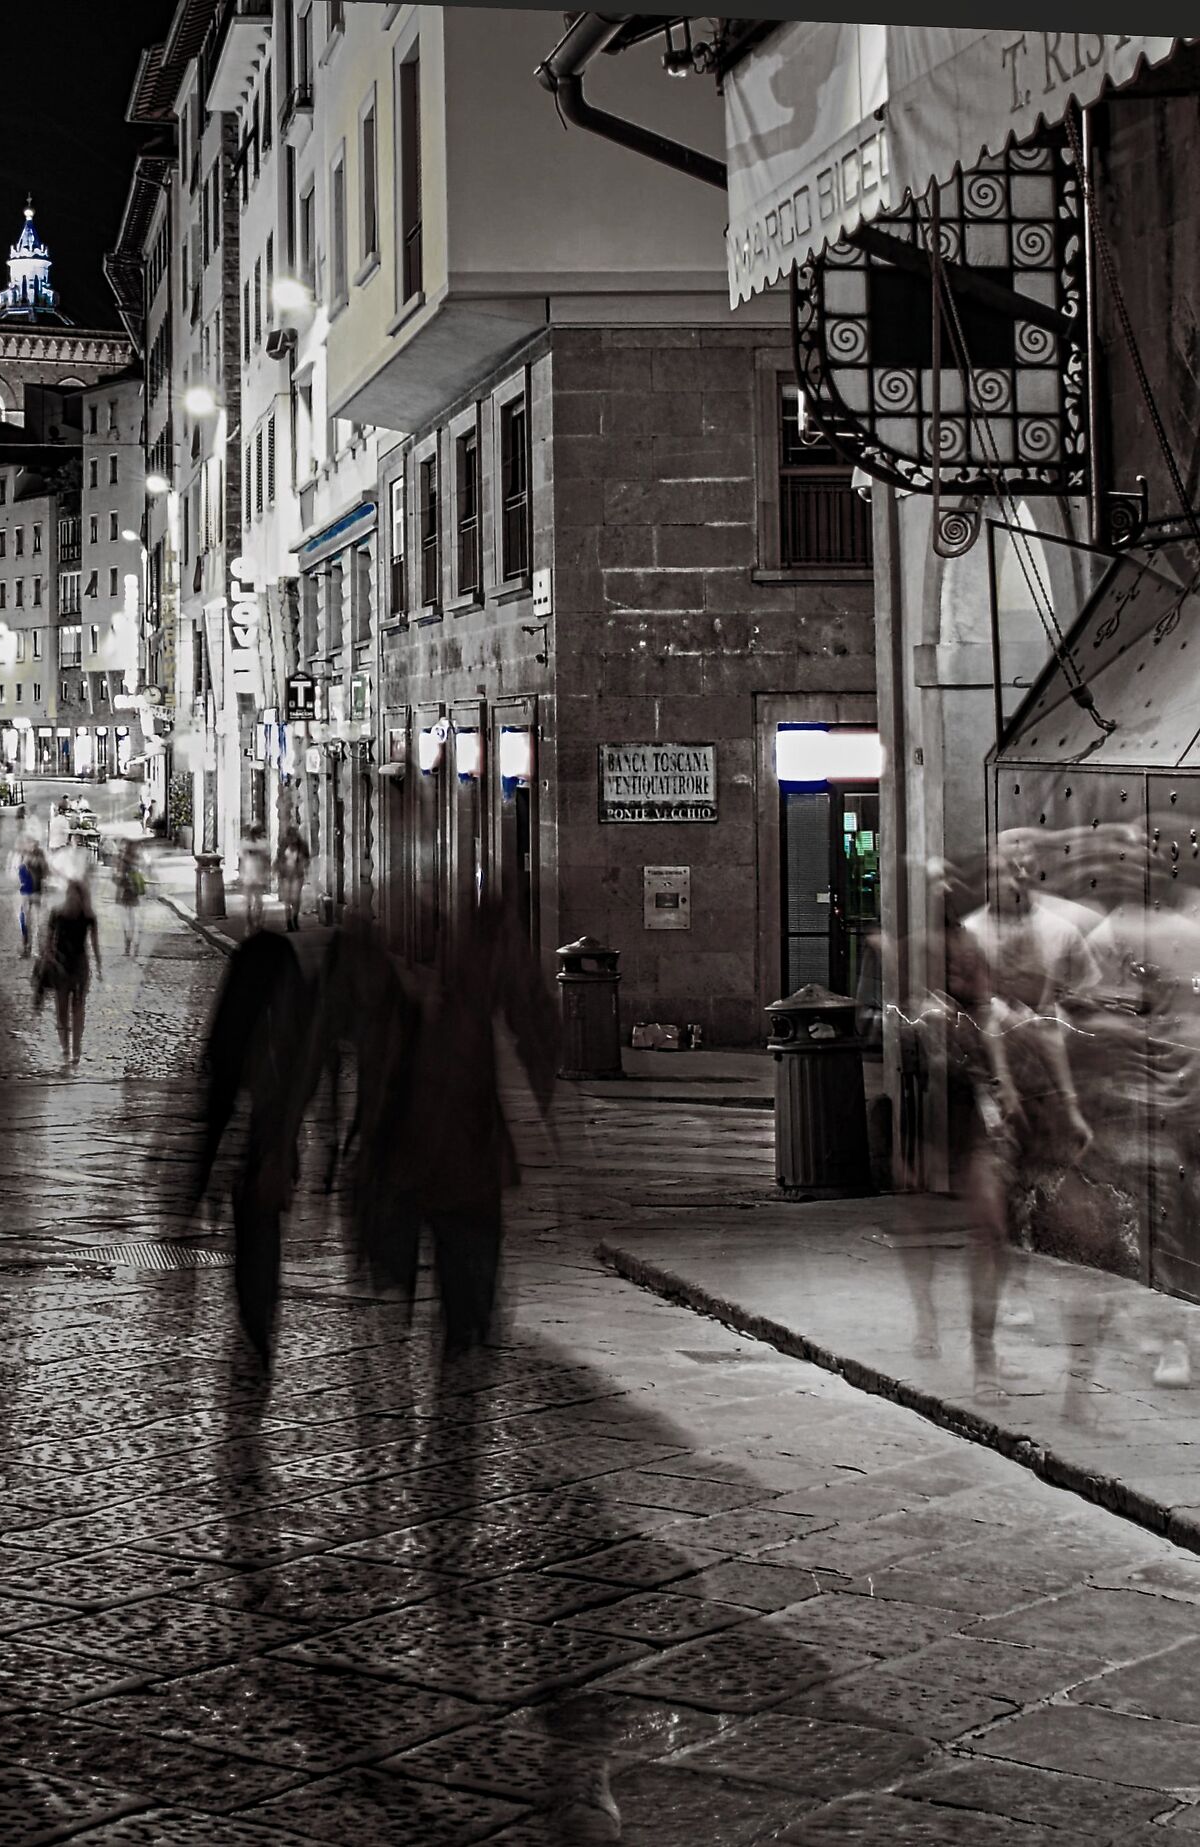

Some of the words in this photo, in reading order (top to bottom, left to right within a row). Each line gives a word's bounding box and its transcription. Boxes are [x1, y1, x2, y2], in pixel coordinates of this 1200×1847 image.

[734, 185, 811, 284] MARCO
[290, 681, 312, 707] T
[607, 752, 647, 773] BANCA
[652, 752, 709, 773] TOSCANA
[607, 775, 709, 799] VENTIQUATTRORE
[607, 808, 649, 820] PONTE
[653, 807, 711, 820] VECCHIO
